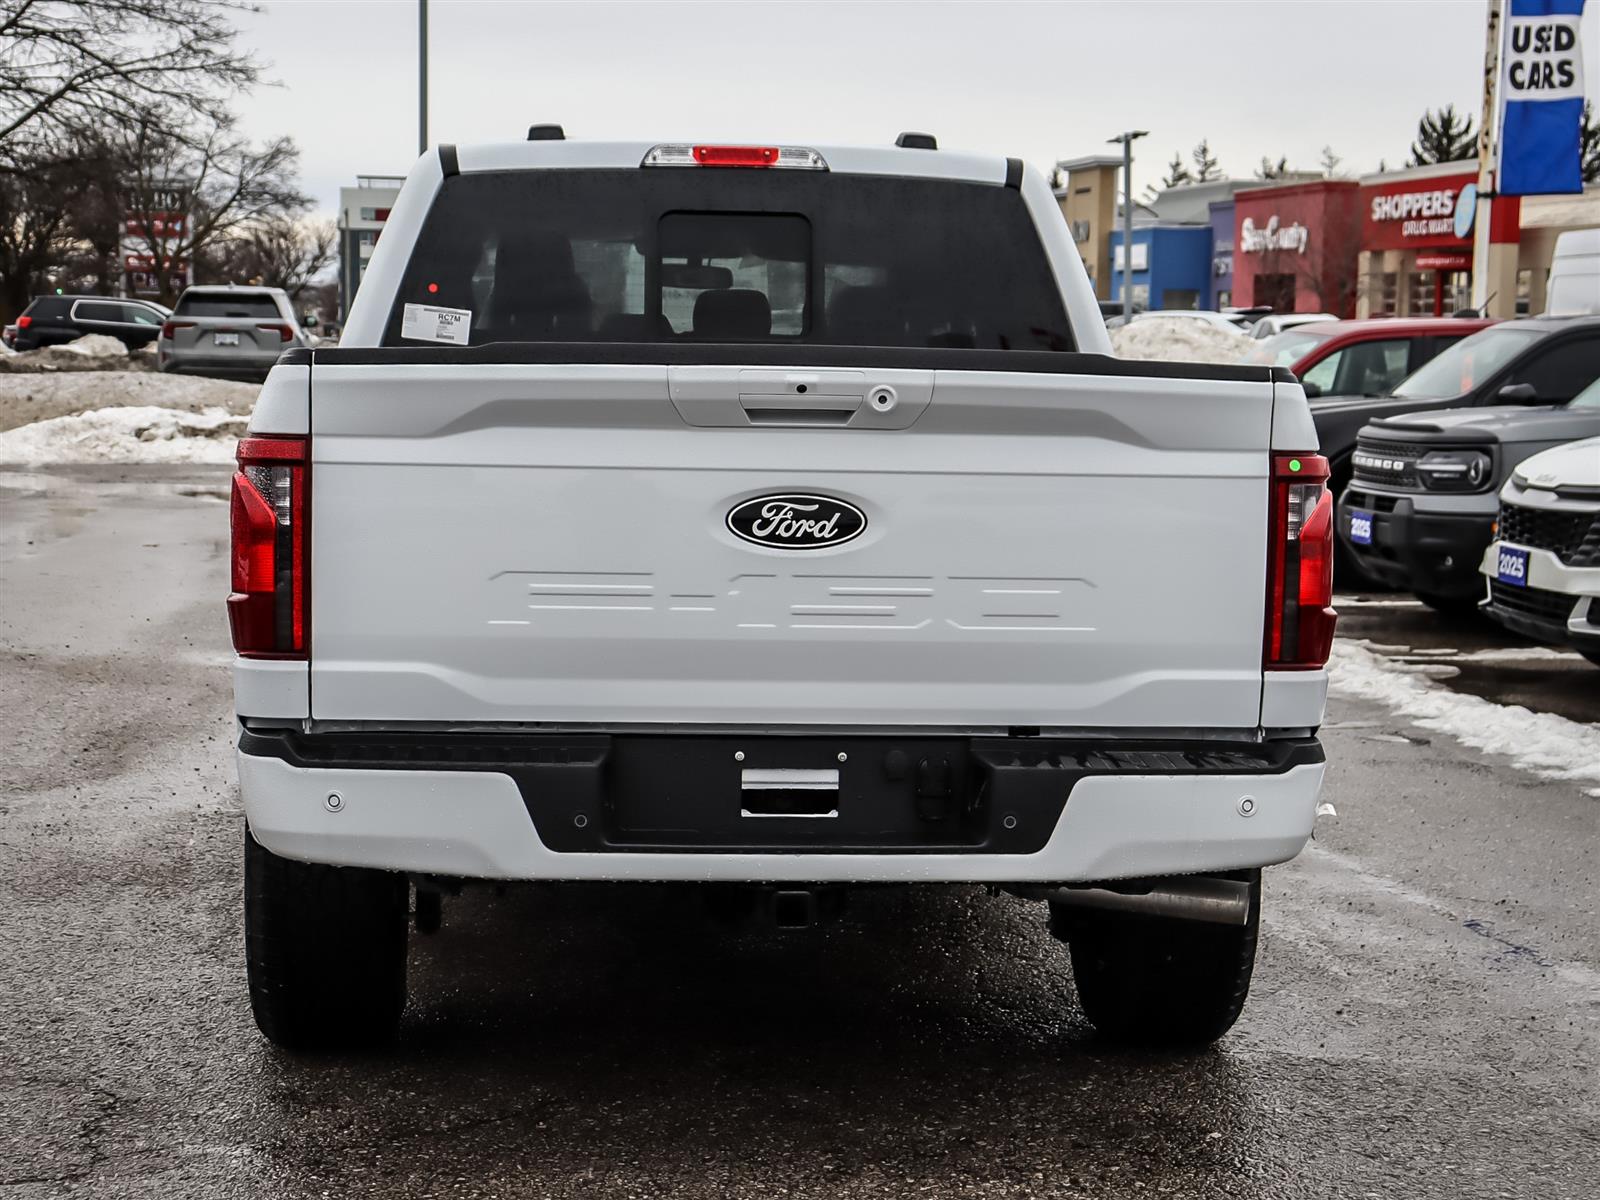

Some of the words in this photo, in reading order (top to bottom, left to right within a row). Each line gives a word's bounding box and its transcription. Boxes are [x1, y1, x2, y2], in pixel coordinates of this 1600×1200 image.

[1509, 59, 1575, 90] CARS
[1371, 189, 1454, 222] SHOPPERS
[438, 313, 461, 322] RC7M
[752, 502, 840, 538] Ford
[1500, 553, 1524, 577] 2025
